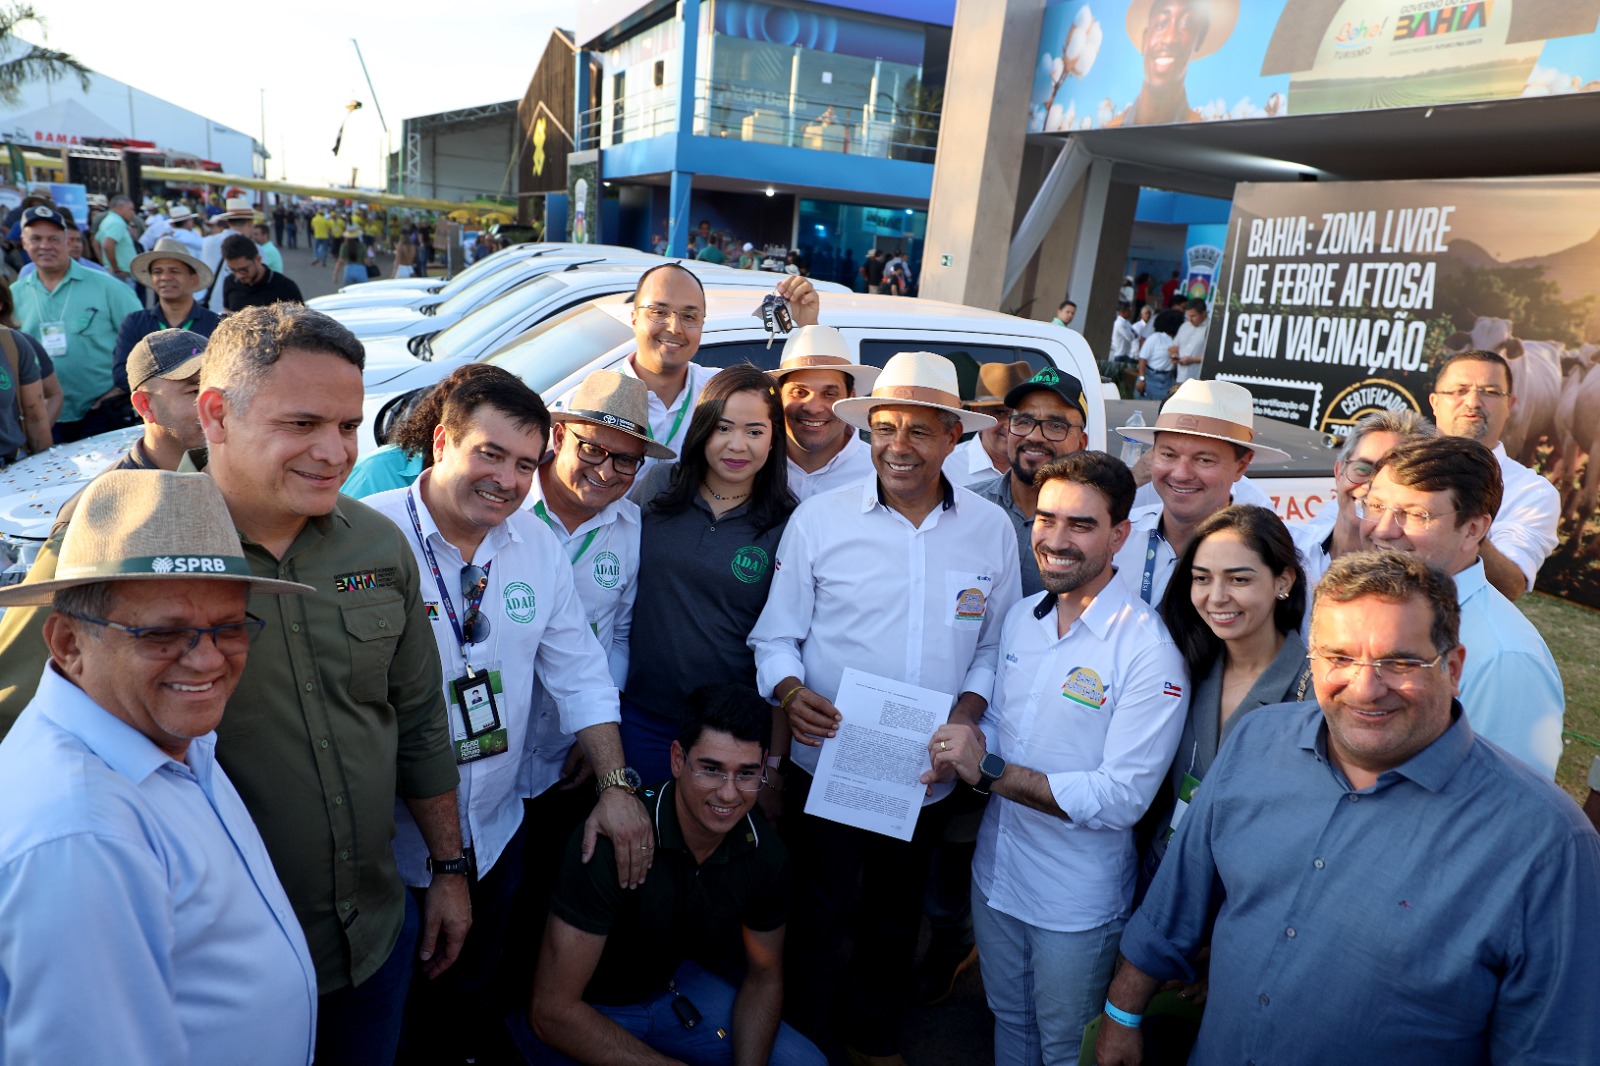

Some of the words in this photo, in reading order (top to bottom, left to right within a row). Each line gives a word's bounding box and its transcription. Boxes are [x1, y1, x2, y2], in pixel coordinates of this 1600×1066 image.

[1393, 1, 1487, 41] BAHIA
[1333, 46, 1372, 60] TURISMO
[34, 131, 81, 145] BAMA
[1247, 216, 1315, 257] BAHIA:
[1316, 210, 1376, 255] ZONA
[1380, 206, 1456, 253] LIVRE
[1241, 263, 1269, 304] DE
[1270, 263, 1340, 307] FEBRE
[1339, 262, 1436, 310] AFTOSA
[1233, 313, 1283, 359] SEM
[1285, 312, 1429, 375] VACINAÇÃO.
[1263, 407, 1290, 419] Mundial
[174, 558, 226, 573] SPRB
[594, 564, 620, 576] ADAB
[736, 554, 766, 575] ADAB
[335, 574, 377, 593] BAHIA
[505, 596, 536, 611] ADAB
[460, 740, 479, 750] AGRO
